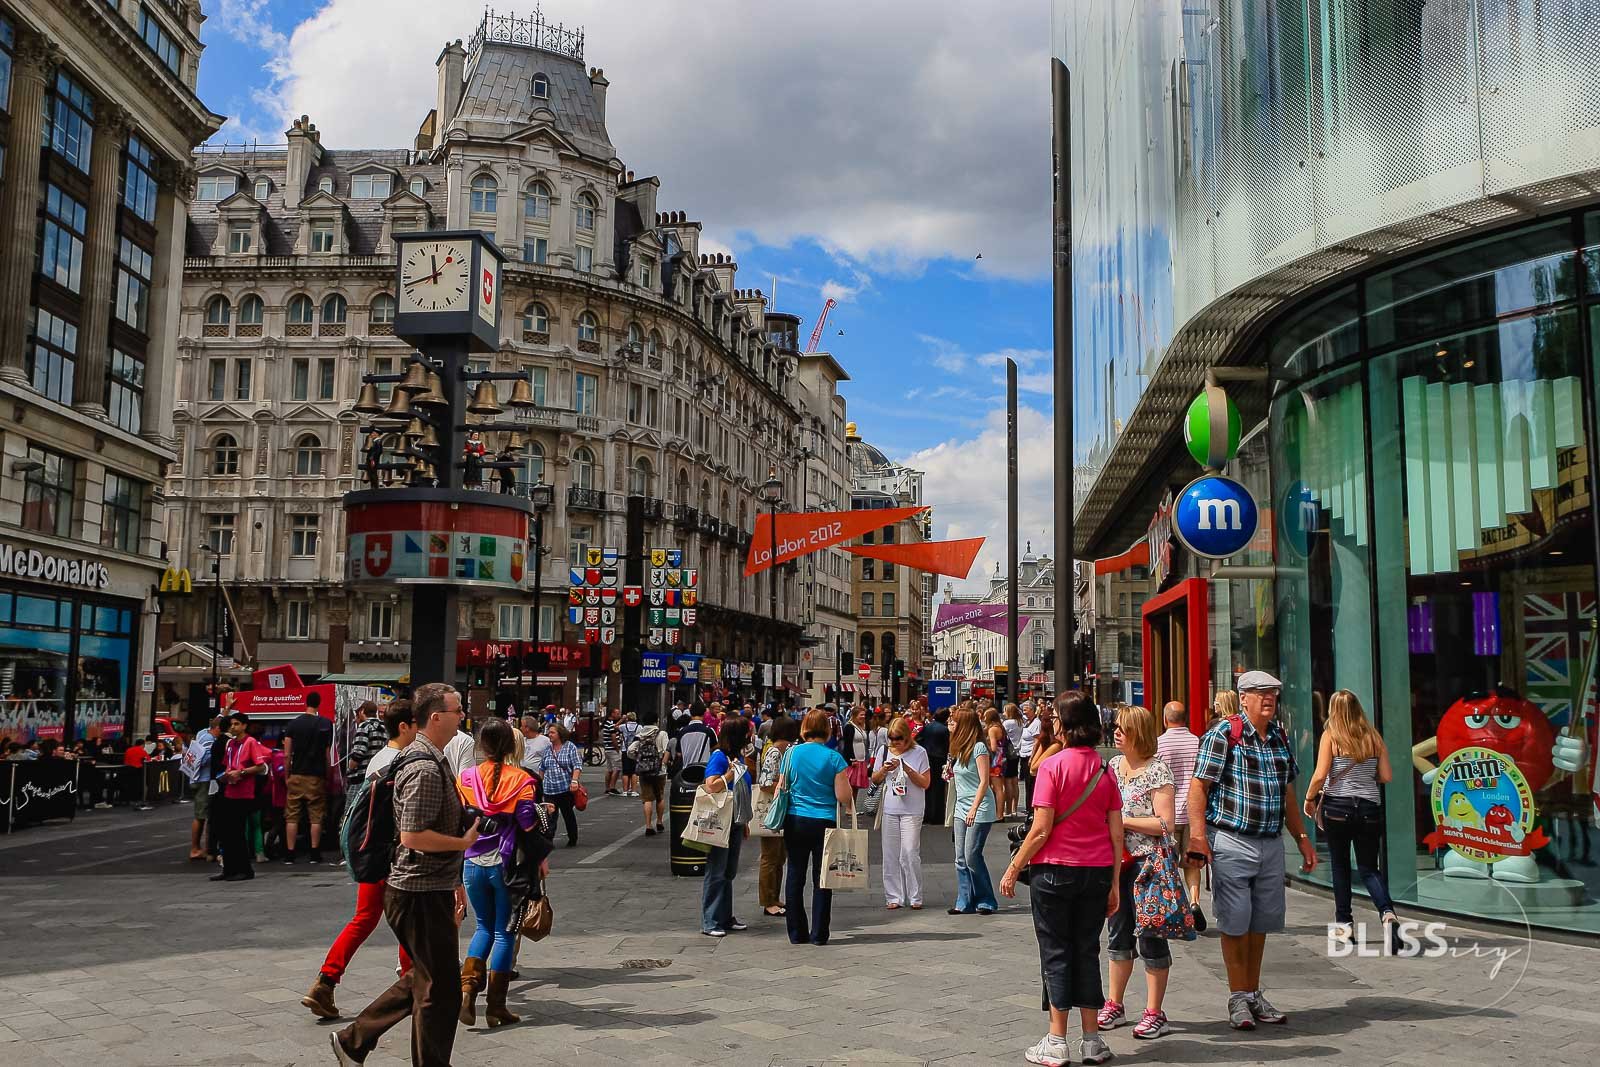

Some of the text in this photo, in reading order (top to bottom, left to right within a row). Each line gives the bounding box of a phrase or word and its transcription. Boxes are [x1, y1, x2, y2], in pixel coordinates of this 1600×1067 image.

[1198, 498, 1242, 530] m
[809, 521, 843, 545] 2012
[0, 543, 109, 588] McDonald's
[936, 608, 983, 629] London 2012
[643, 658, 661, 668] NEY
[273, 693, 303, 703] question?
[1465, 778, 1498, 791] WORLD
[1482, 791, 1510, 801] London
[1464, 833, 1483, 843] World
[1483, 836, 1523, 850] Celebration!
